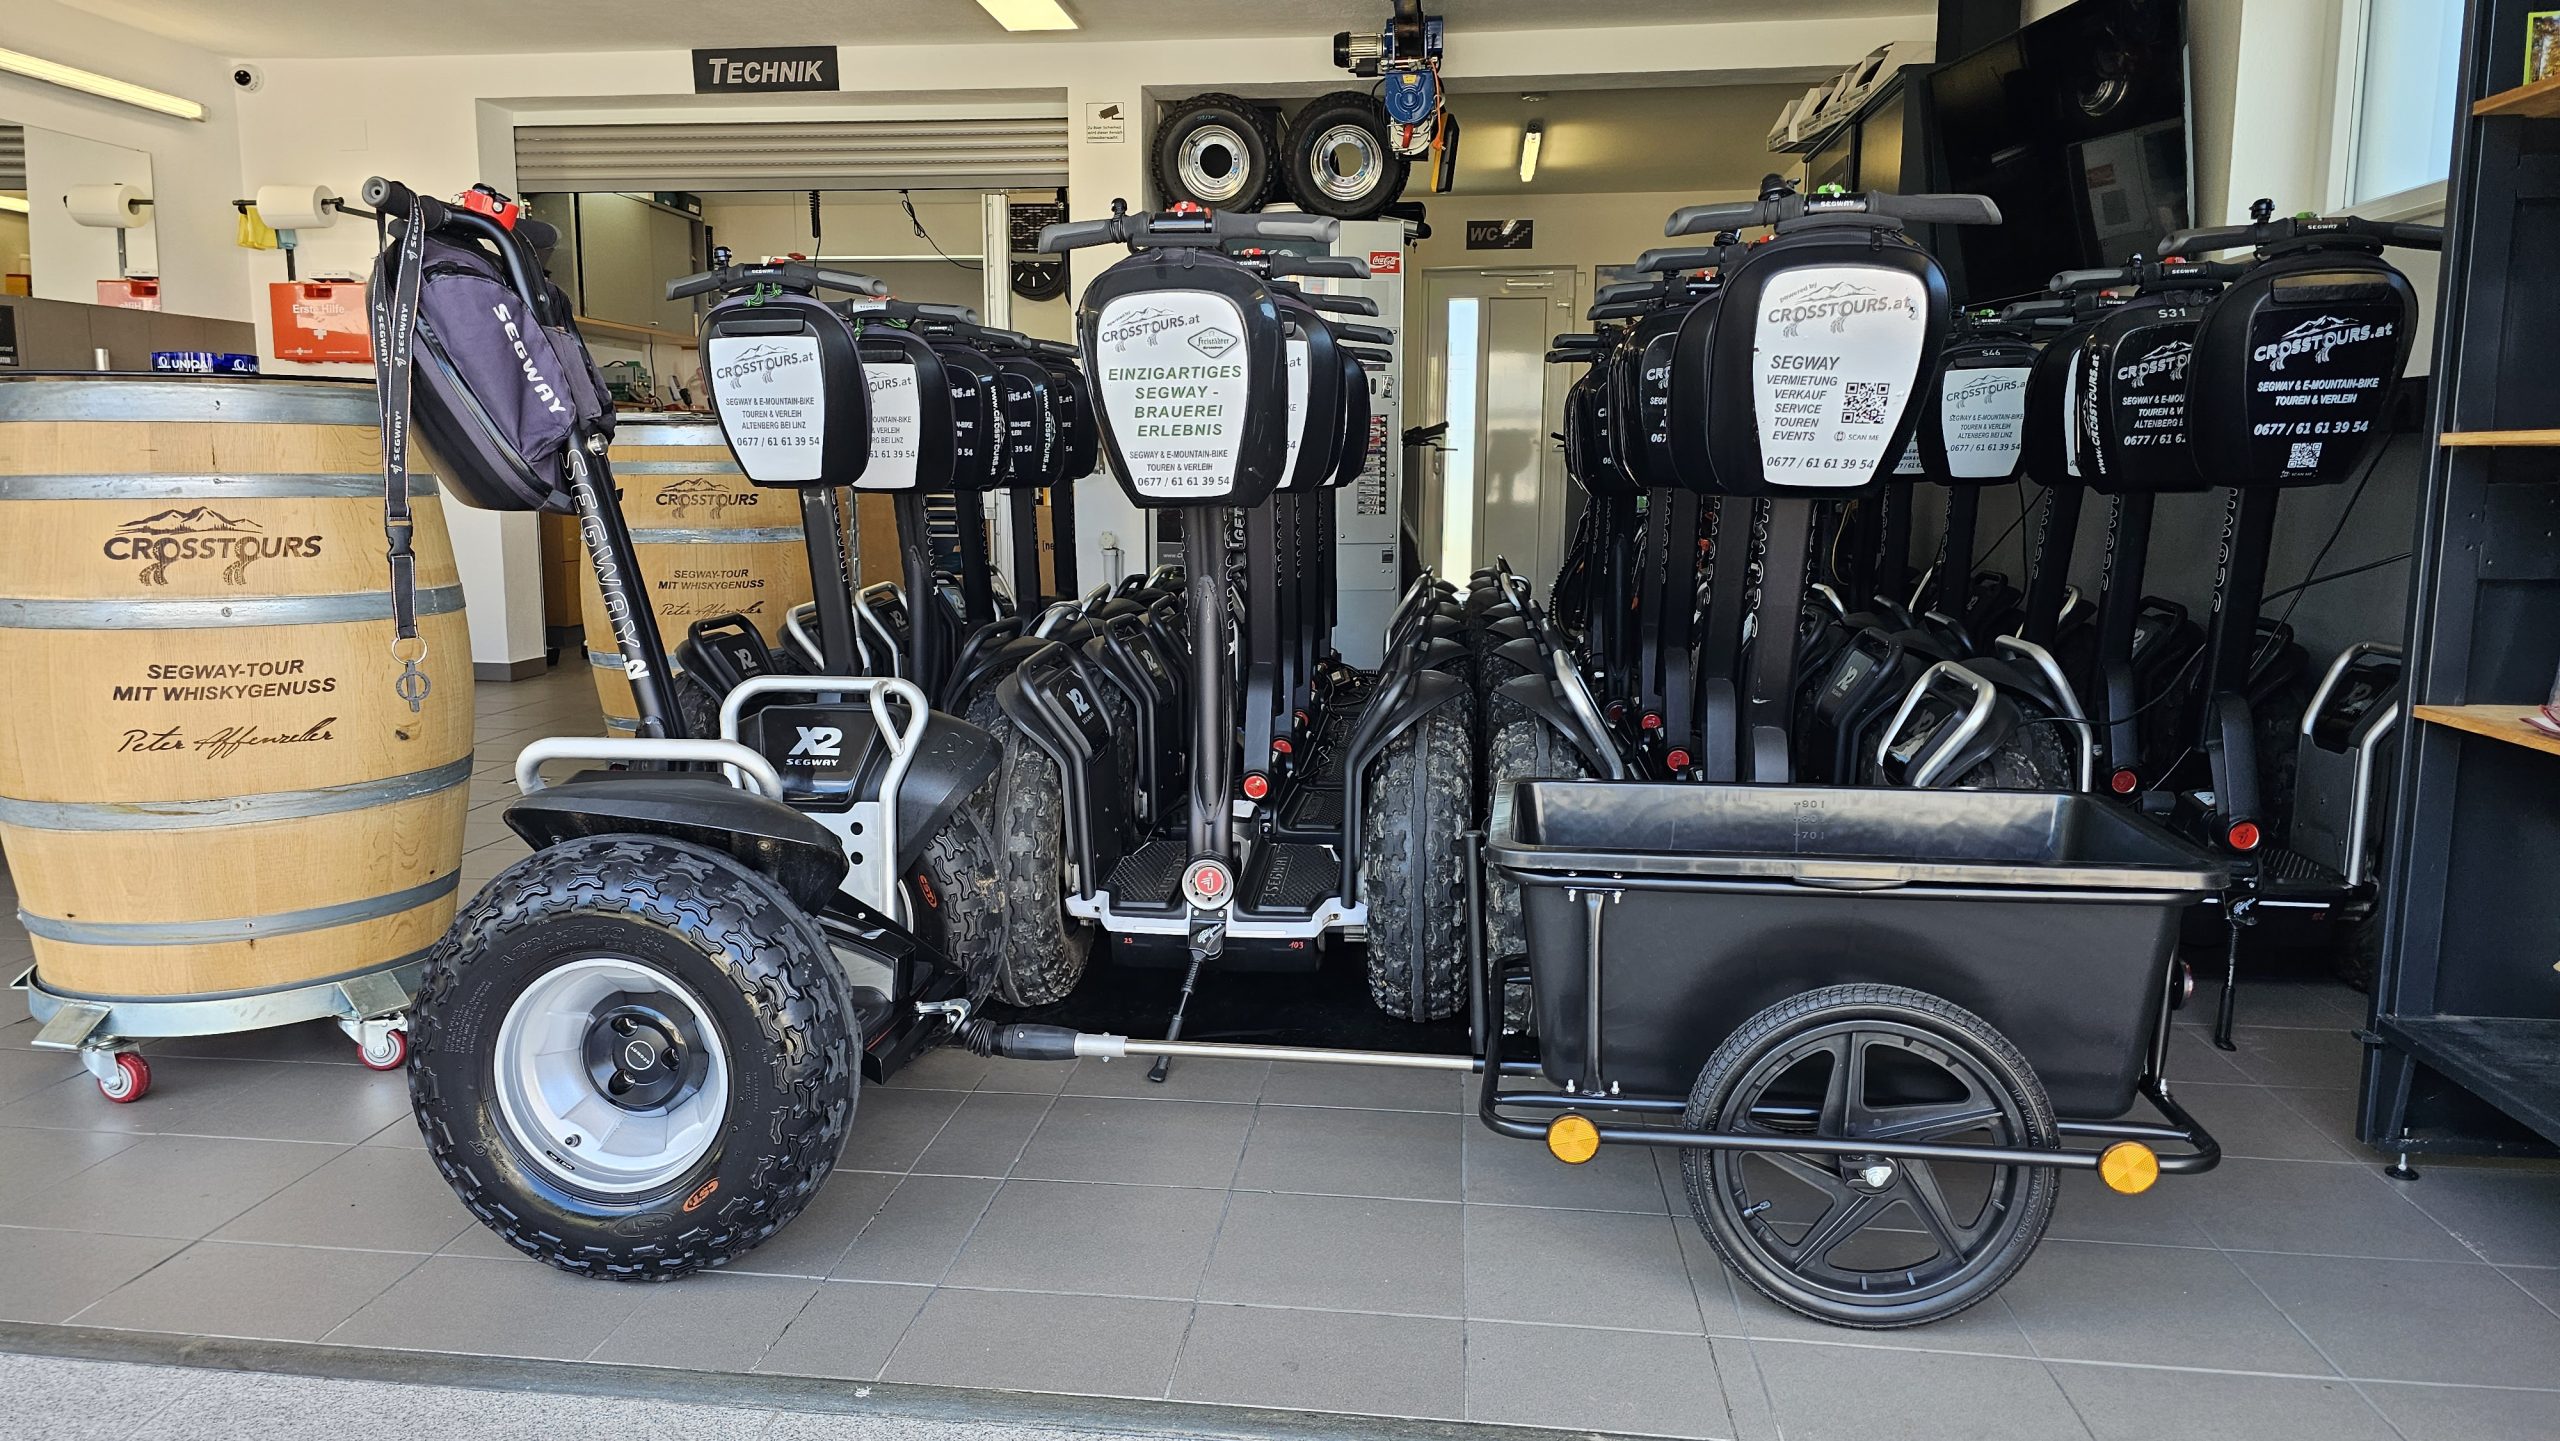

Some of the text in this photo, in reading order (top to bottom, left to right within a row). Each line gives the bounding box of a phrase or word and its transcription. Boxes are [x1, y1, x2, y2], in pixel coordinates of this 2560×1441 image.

[708, 58, 823, 84] TECHNIK
[1470, 227, 1498, 241] WC
[321, 303, 344, 314] Hilfe
[1767, 296, 1911, 324] CROSSTOURS.at
[2158, 308, 2186, 318] S31
[398, 305, 409, 354] SEGWAY
[1101, 314, 1200, 343] CROSSTOURS.at
[378, 314, 389, 366] SEGWAY
[2253, 322, 2393, 363] CROSSTOURS.at
[492, 303, 566, 414] SEGWAY
[1770, 355, 1840, 371] SEGWAY
[716, 351, 814, 380] CROSSTOURS.at
[1108, 365, 1242, 381] EINZIGARTIGES
[1767, 374, 1838, 386] VERMIETUNG
[2257, 380, 2294, 392] SEGWAY
[2302, 378, 2380, 390] E-MOUNTAIN-BIKE
[1135, 386, 1208, 400] SEGWAY
[1774, 389, 1827, 400] VERKAUF
[1946, 380, 2026, 402] CROSSTOURS.a
[725, 397, 752, 406] SEGWAY
[759, 396, 815, 406] E-MOUNTAIN-BIKE
[2122, 396, 2152, 406] SEGWAY
[2275, 395, 2310, 406] TOUREN
[2320, 394, 2358, 404] VERLEIH
[742, 410, 768, 418] TOUREN
[774, 410, 802, 418] VERLEIH
[1134, 404, 1223, 418] BRAUEREI
[1774, 404, 1822, 414] SERVICE
[2138, 408, 2168, 416] TOUREN
[741, 422, 806, 430] ALTENBERG BEI LINZ
[1774, 418, 1820, 428] TOUREN
[2134, 420, 2178, 428] ALTENBERG
[2253, 422, 2286, 436] 0677
[2296, 422, 2311, 434] 61
[2314, 422, 2330, 434] 61
[2332, 422, 2350, 434] 39
[2352, 421, 2368, 433] 54
[393, 411, 402, 461] SEGWAY
[1137, 424, 1223, 437] ERLEBNIS
[1772, 431, 1816, 441] EVENTS
[737, 436, 758, 446] 0677
[767, 436, 778, 446] 61
[780, 436, 793, 446] 61
[794, 436, 806, 446] 39
[808, 436, 820, 446] 54
[1651, 434, 1666, 442] 067
[2124, 435, 2150, 446] 0677
[2159, 434, 2172, 444] 61
[904, 450, 915, 458] 54
[1130, 450, 1160, 459] SEGWAY
[1166, 450, 1228, 458] E-MOUNTAIN-BIKE
[1950, 444, 1968, 452] 0677
[1147, 464, 1176, 472] TOUREN
[1184, 463, 1213, 471] VERLEIH
[1766, 456, 1796, 468] 0677
[1806, 458, 1820, 468] 61
[1824, 458, 1838, 468] 61
[1841, 458, 1856, 470] 39
[1859, 458, 1874, 470] 54
[1138, 478, 1162, 487] 0677
[1171, 477, 1183, 486] 61
[1186, 477, 1198, 486] 61
[1202, 477, 1215, 486] 39
[1218, 476, 1230, 486] 54
[655, 493, 759, 506] CROSSTOURS
[103, 535, 324, 562] CROSSTOURS
[559, 449, 640, 648] SEGWAY
[673, 568, 749, 579] SEGWAY-TOUR
[658, 580, 765, 590] MIT WHISKYGENUSS
[146, 659, 304, 680] SEGWAY-TOUR
[112, 677, 337, 702] MIT WHISKYGENUSS
[117, 725, 185, 753] Peter
[788, 726, 843, 757] X2
[786, 758, 839, 766] SEGWAY
